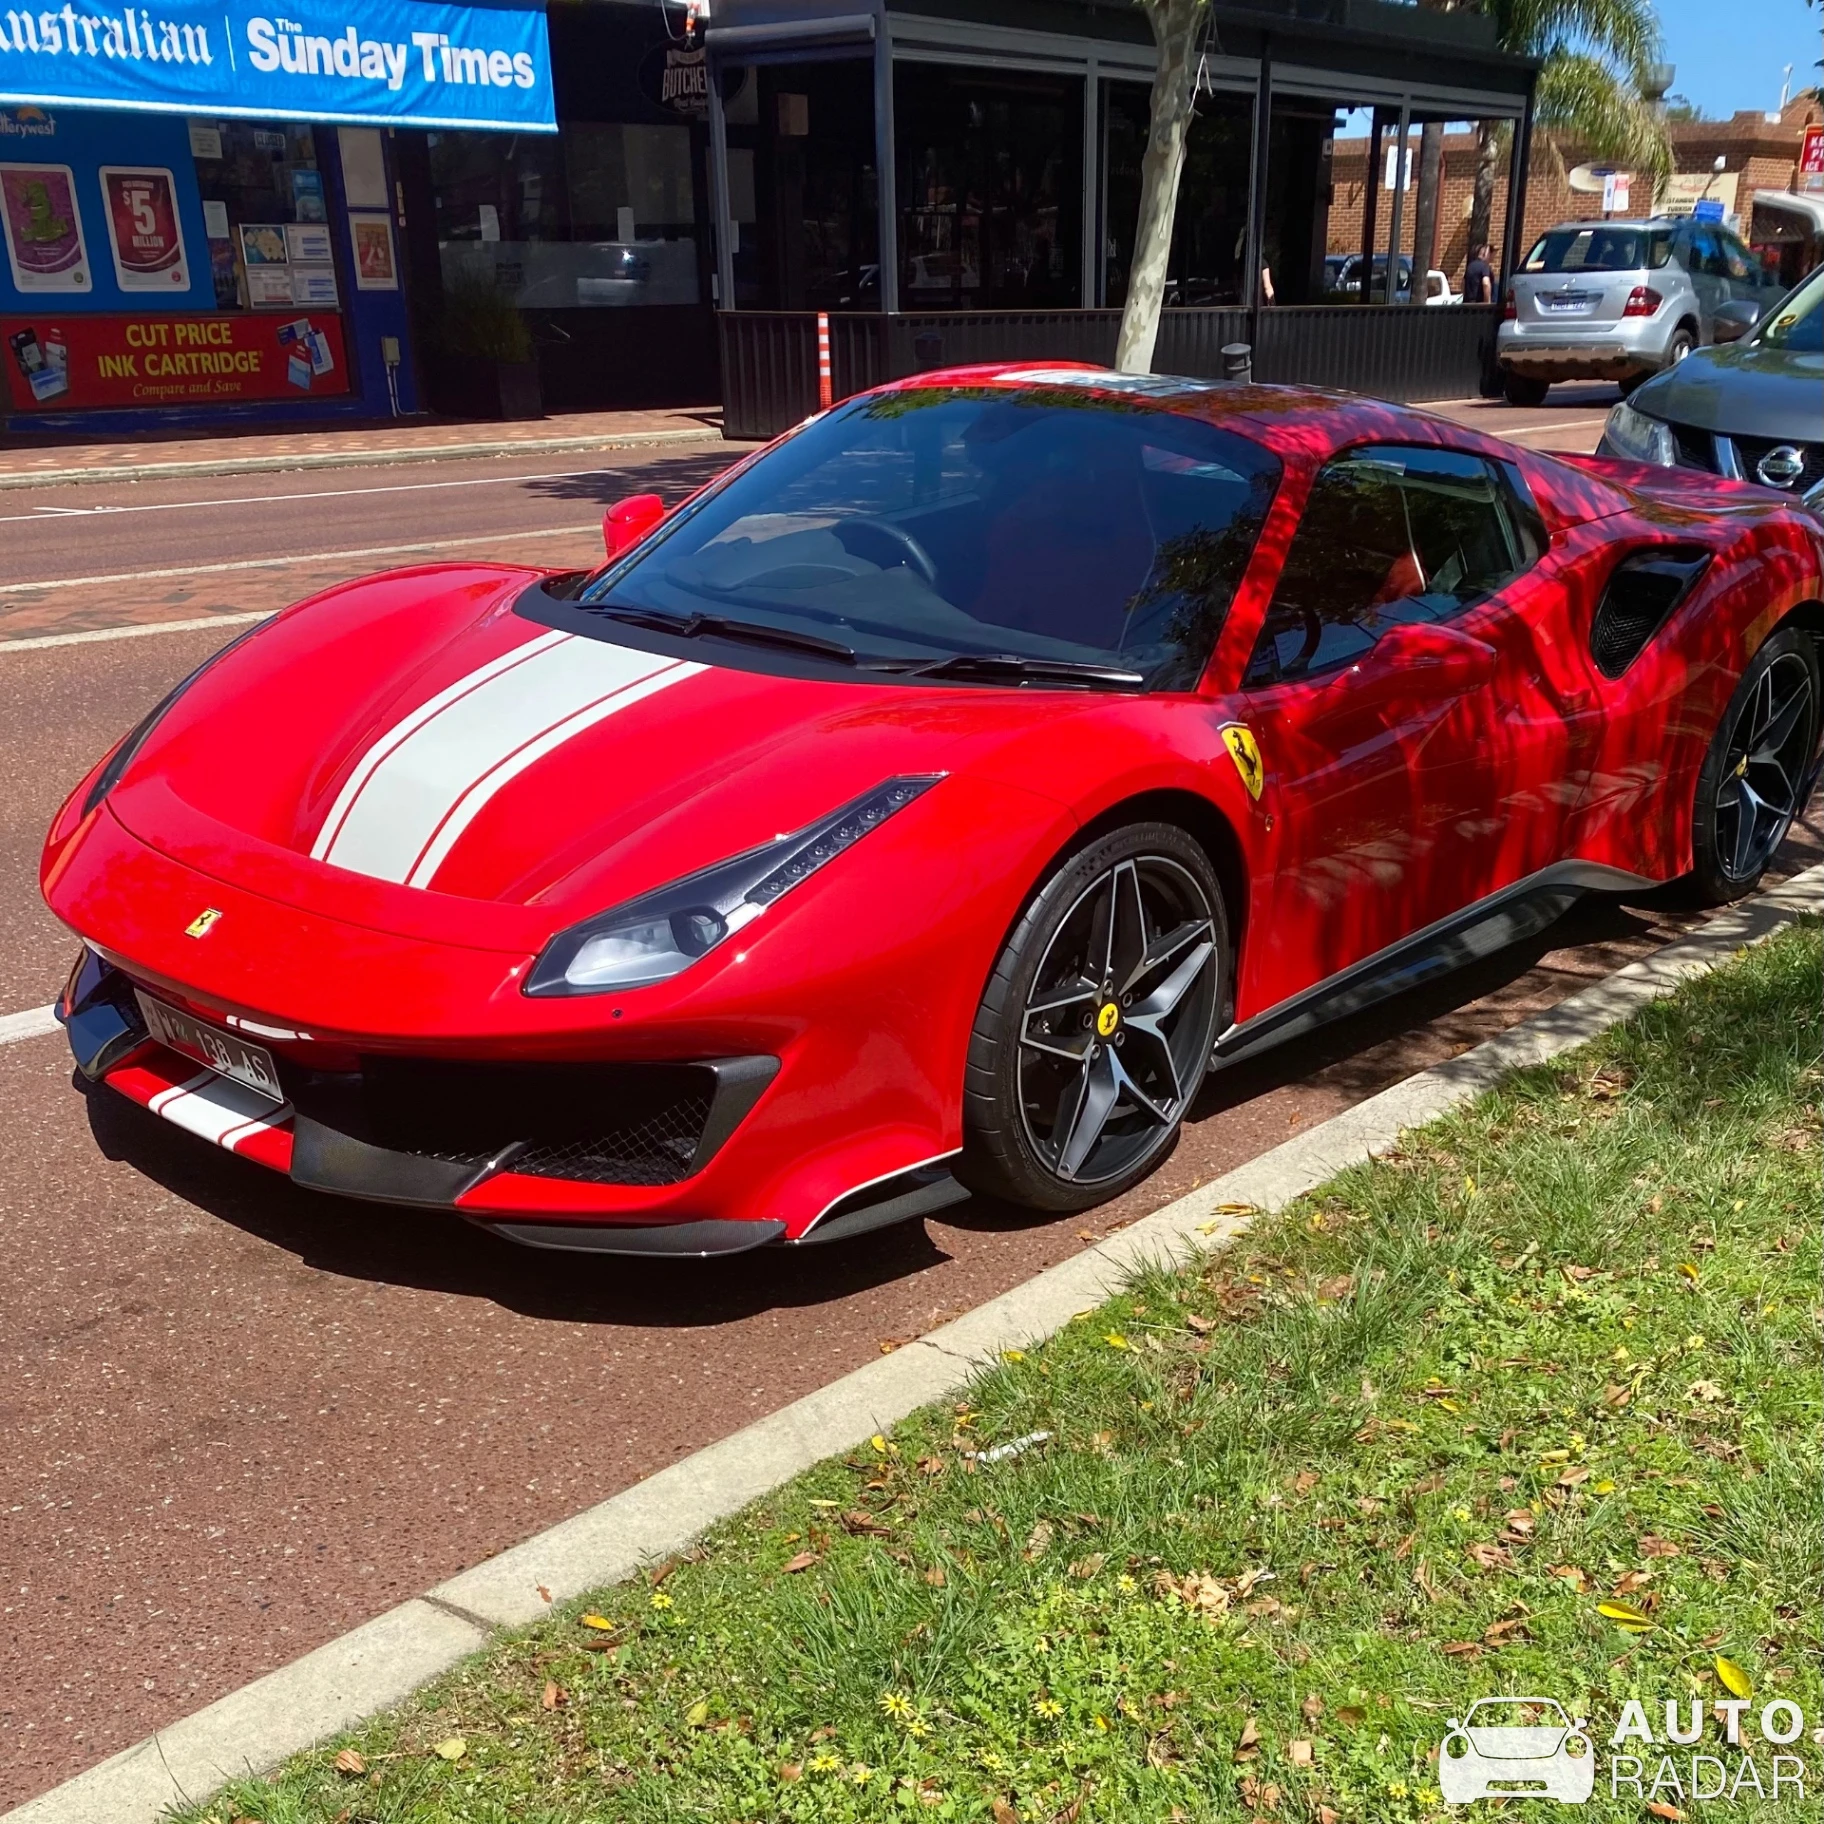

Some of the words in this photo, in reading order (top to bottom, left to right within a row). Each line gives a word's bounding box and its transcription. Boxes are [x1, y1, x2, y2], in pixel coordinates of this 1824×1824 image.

[0, 3, 213, 66] ustralian
[275, 18, 302, 33] The
[247, 17, 407, 91] Sunday
[411, 32, 535, 88] Times
[662, 66, 708, 101] BUTCHE
[132, 235, 165, 248] MILLION
[126, 324, 169, 347] CUT
[174, 322, 233, 346] PRICE
[98, 355, 139, 378] INK
[144, 350, 261, 376] CARTRIDGE
[133, 383, 185, 400] Compare
[189, 379, 212, 394] and
[214, 380, 242, 394] Save
[195, 1029, 233, 1069] 138
[240, 1050, 270, 1085] AS
